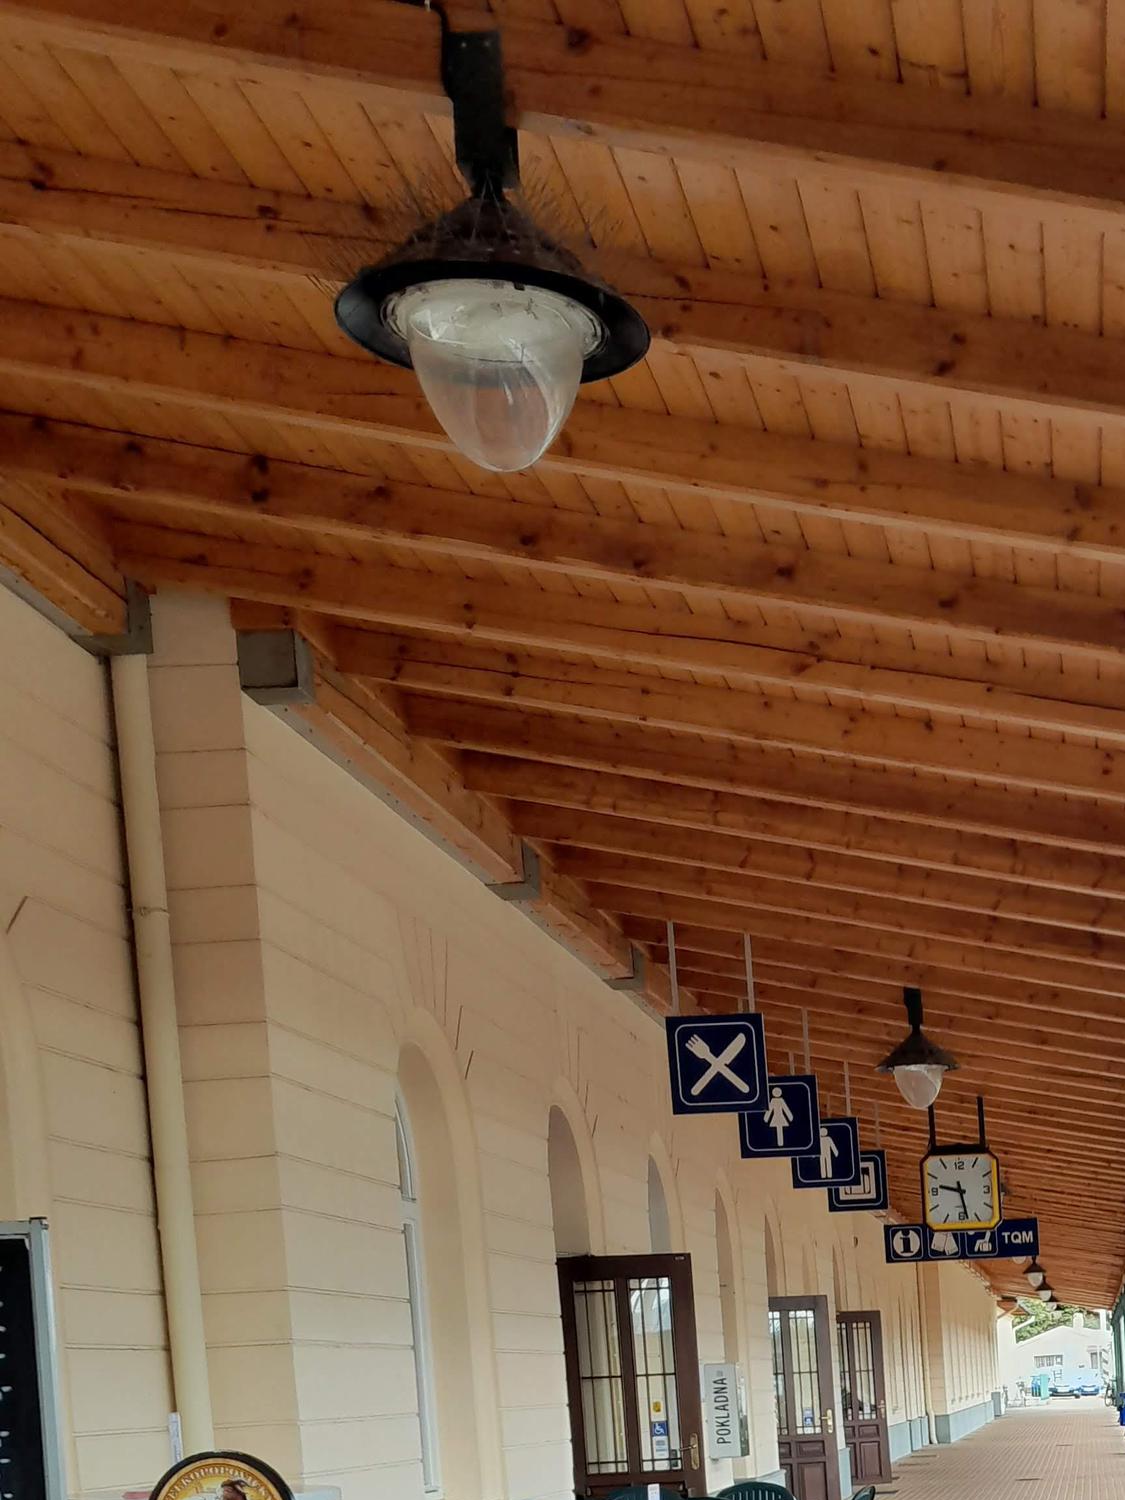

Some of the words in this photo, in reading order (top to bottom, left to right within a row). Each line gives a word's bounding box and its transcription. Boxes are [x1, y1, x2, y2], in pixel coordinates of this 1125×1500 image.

[953, 1160, 965, 1170] 12
[983, 1185, 991, 1194] 3
[1002, 1230, 1034, 1244] TQM
[713, 1376, 732, 1444] POKLADNA
